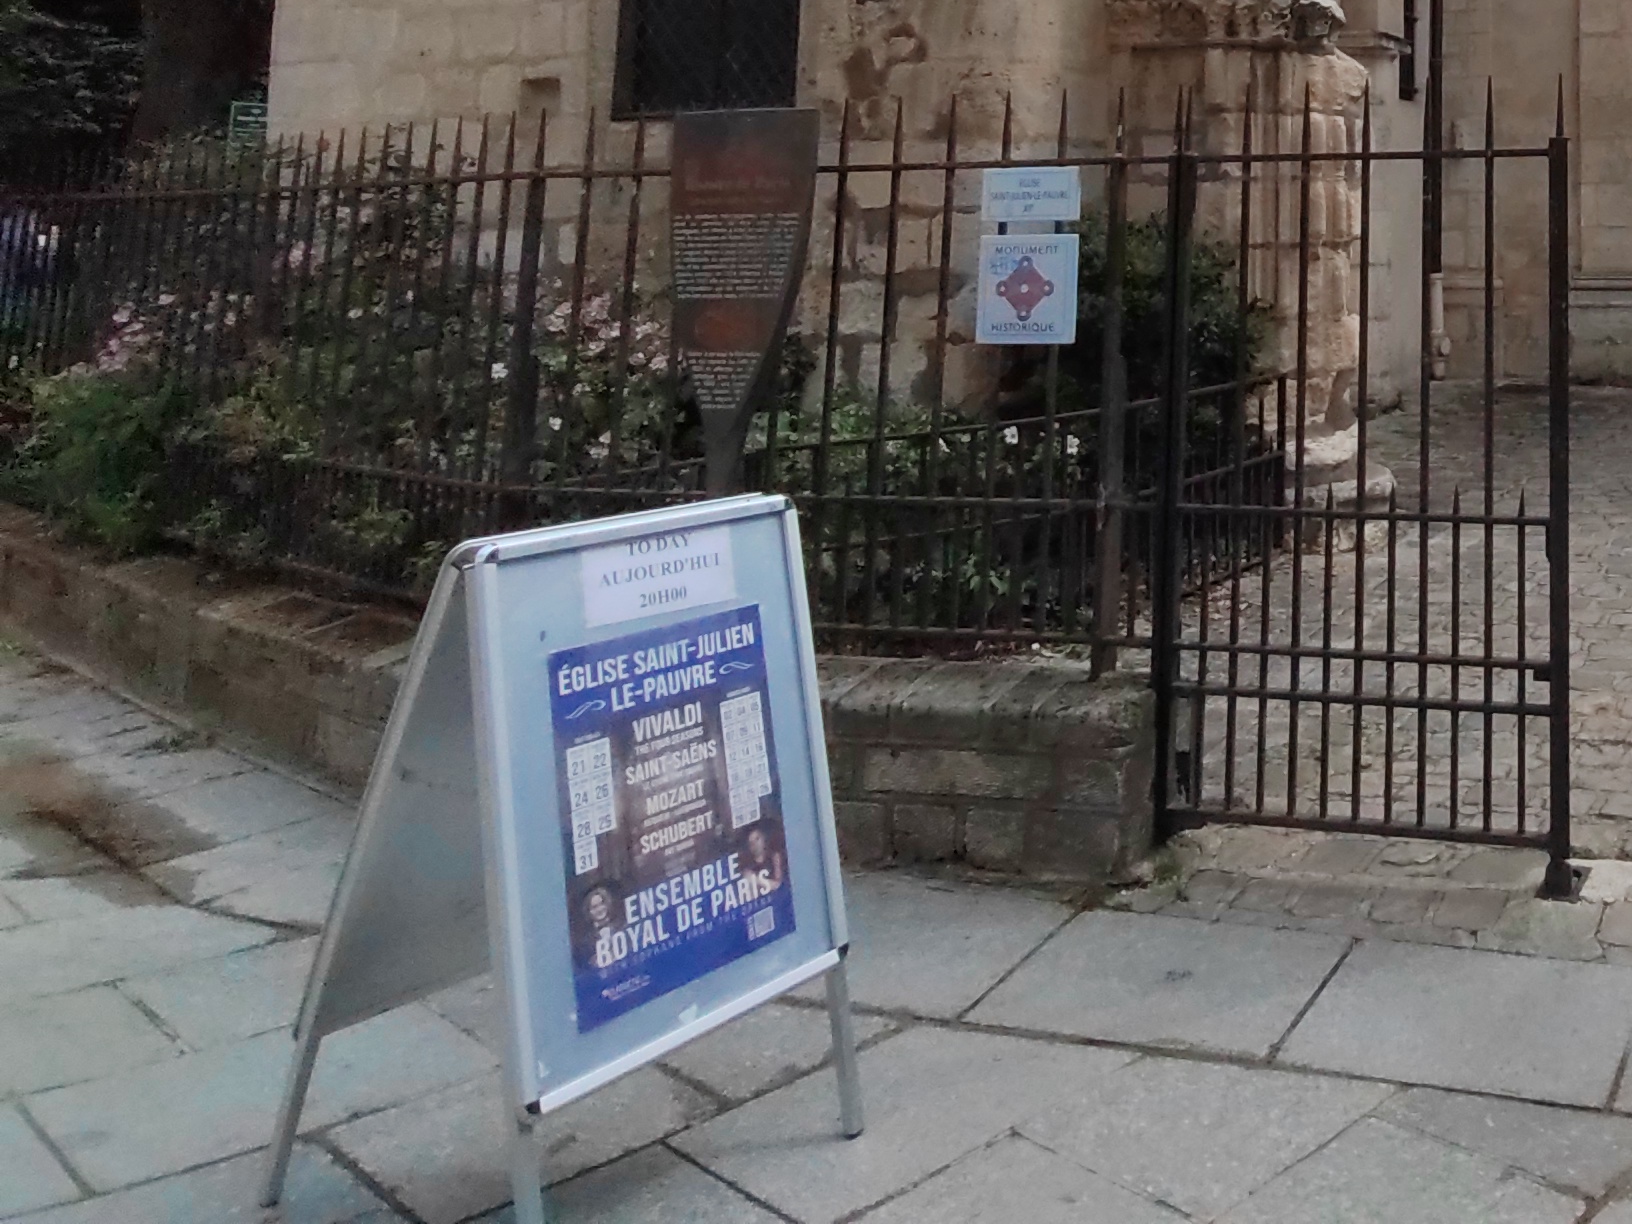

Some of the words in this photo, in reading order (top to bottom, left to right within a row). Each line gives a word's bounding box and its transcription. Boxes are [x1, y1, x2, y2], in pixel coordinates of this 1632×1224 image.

[995, 245, 1058, 255] MONUMENT
[991, 322, 1055, 332] HISTORIQUE
[601, 552, 720, 588] AUJOURD'HUI
[640, 585, 687, 608] 20H00
[558, 654, 630, 697] ÉGLISE
[632, 622, 755, 675] SAINT-JULIEN
[610, 660, 717, 712] LE-PAUVRE
[632, 701, 703, 743] VIVALDI
[572, 759, 585, 776] 21
[592, 752, 607, 769] 22
[624, 739, 718, 786] SAINT-SAËNS
[574, 790, 589, 807] 24
[645, 778, 705, 816] MOZART
[639, 810, 713, 855] SCHUBERT
[579, 853, 593, 871] 31
[624, 852, 742, 925] ENSEMBLE
[595, 913, 670, 969] ROYAL
[676, 896, 705, 933] DE
[710, 868, 772, 918] PARIS
